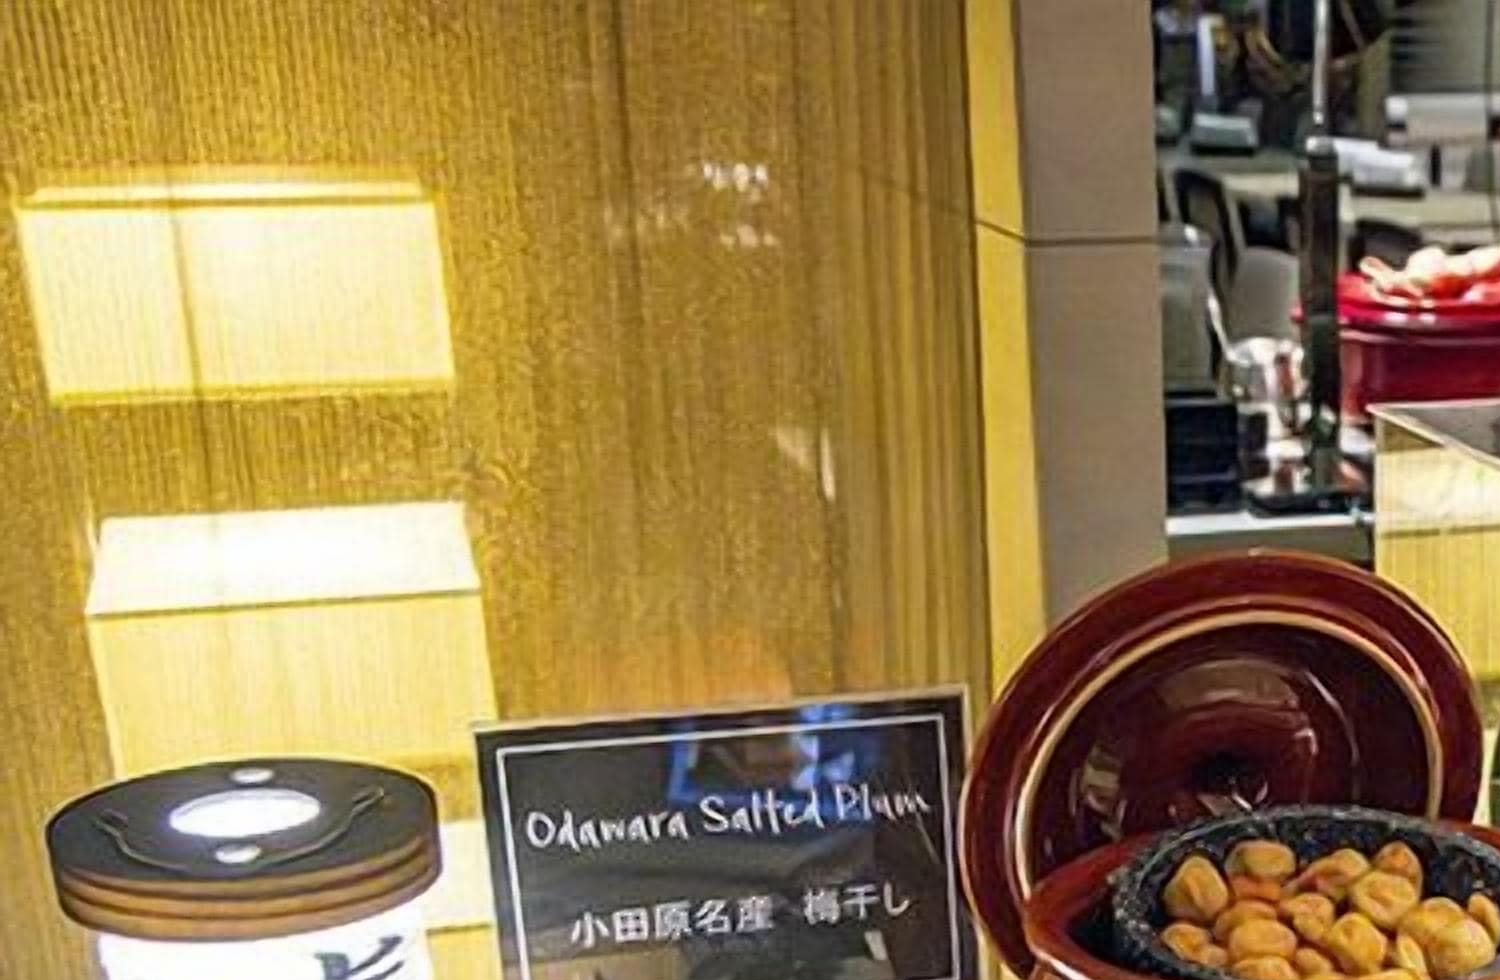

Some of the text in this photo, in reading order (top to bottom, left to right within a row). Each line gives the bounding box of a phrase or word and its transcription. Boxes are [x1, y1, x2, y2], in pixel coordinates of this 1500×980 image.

[526, 782, 931, 853] Odawara Salted Plum
[570, 882, 912, 950] 小田原名産 梅干し
